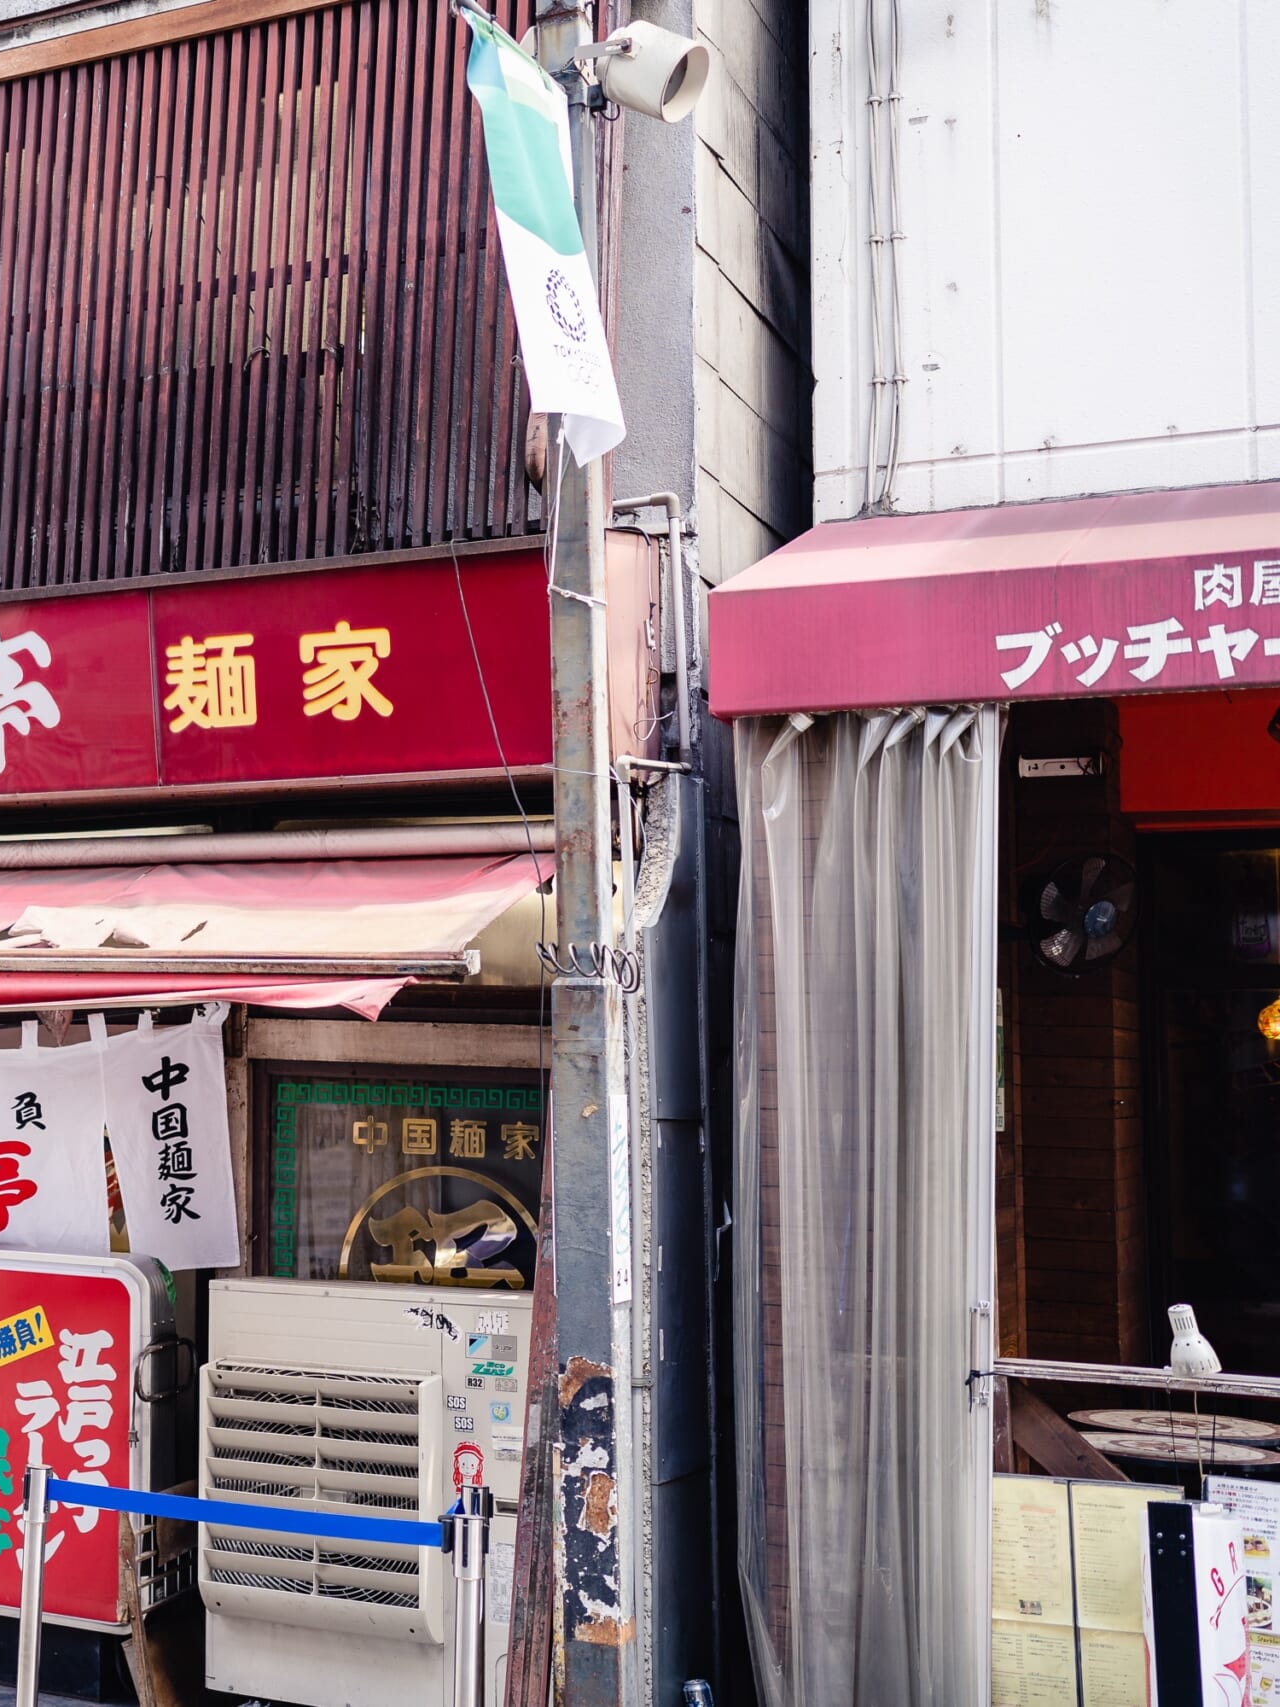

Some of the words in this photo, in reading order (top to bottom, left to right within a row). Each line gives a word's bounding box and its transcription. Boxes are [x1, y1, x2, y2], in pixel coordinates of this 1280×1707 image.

[141, 1056, 202, 1224] 中国麺家
[352, 1115, 540, 1160] 中国麺家
[448, 1396, 466, 1409] SOS
[455, 1417, 473, 1430] SOS
